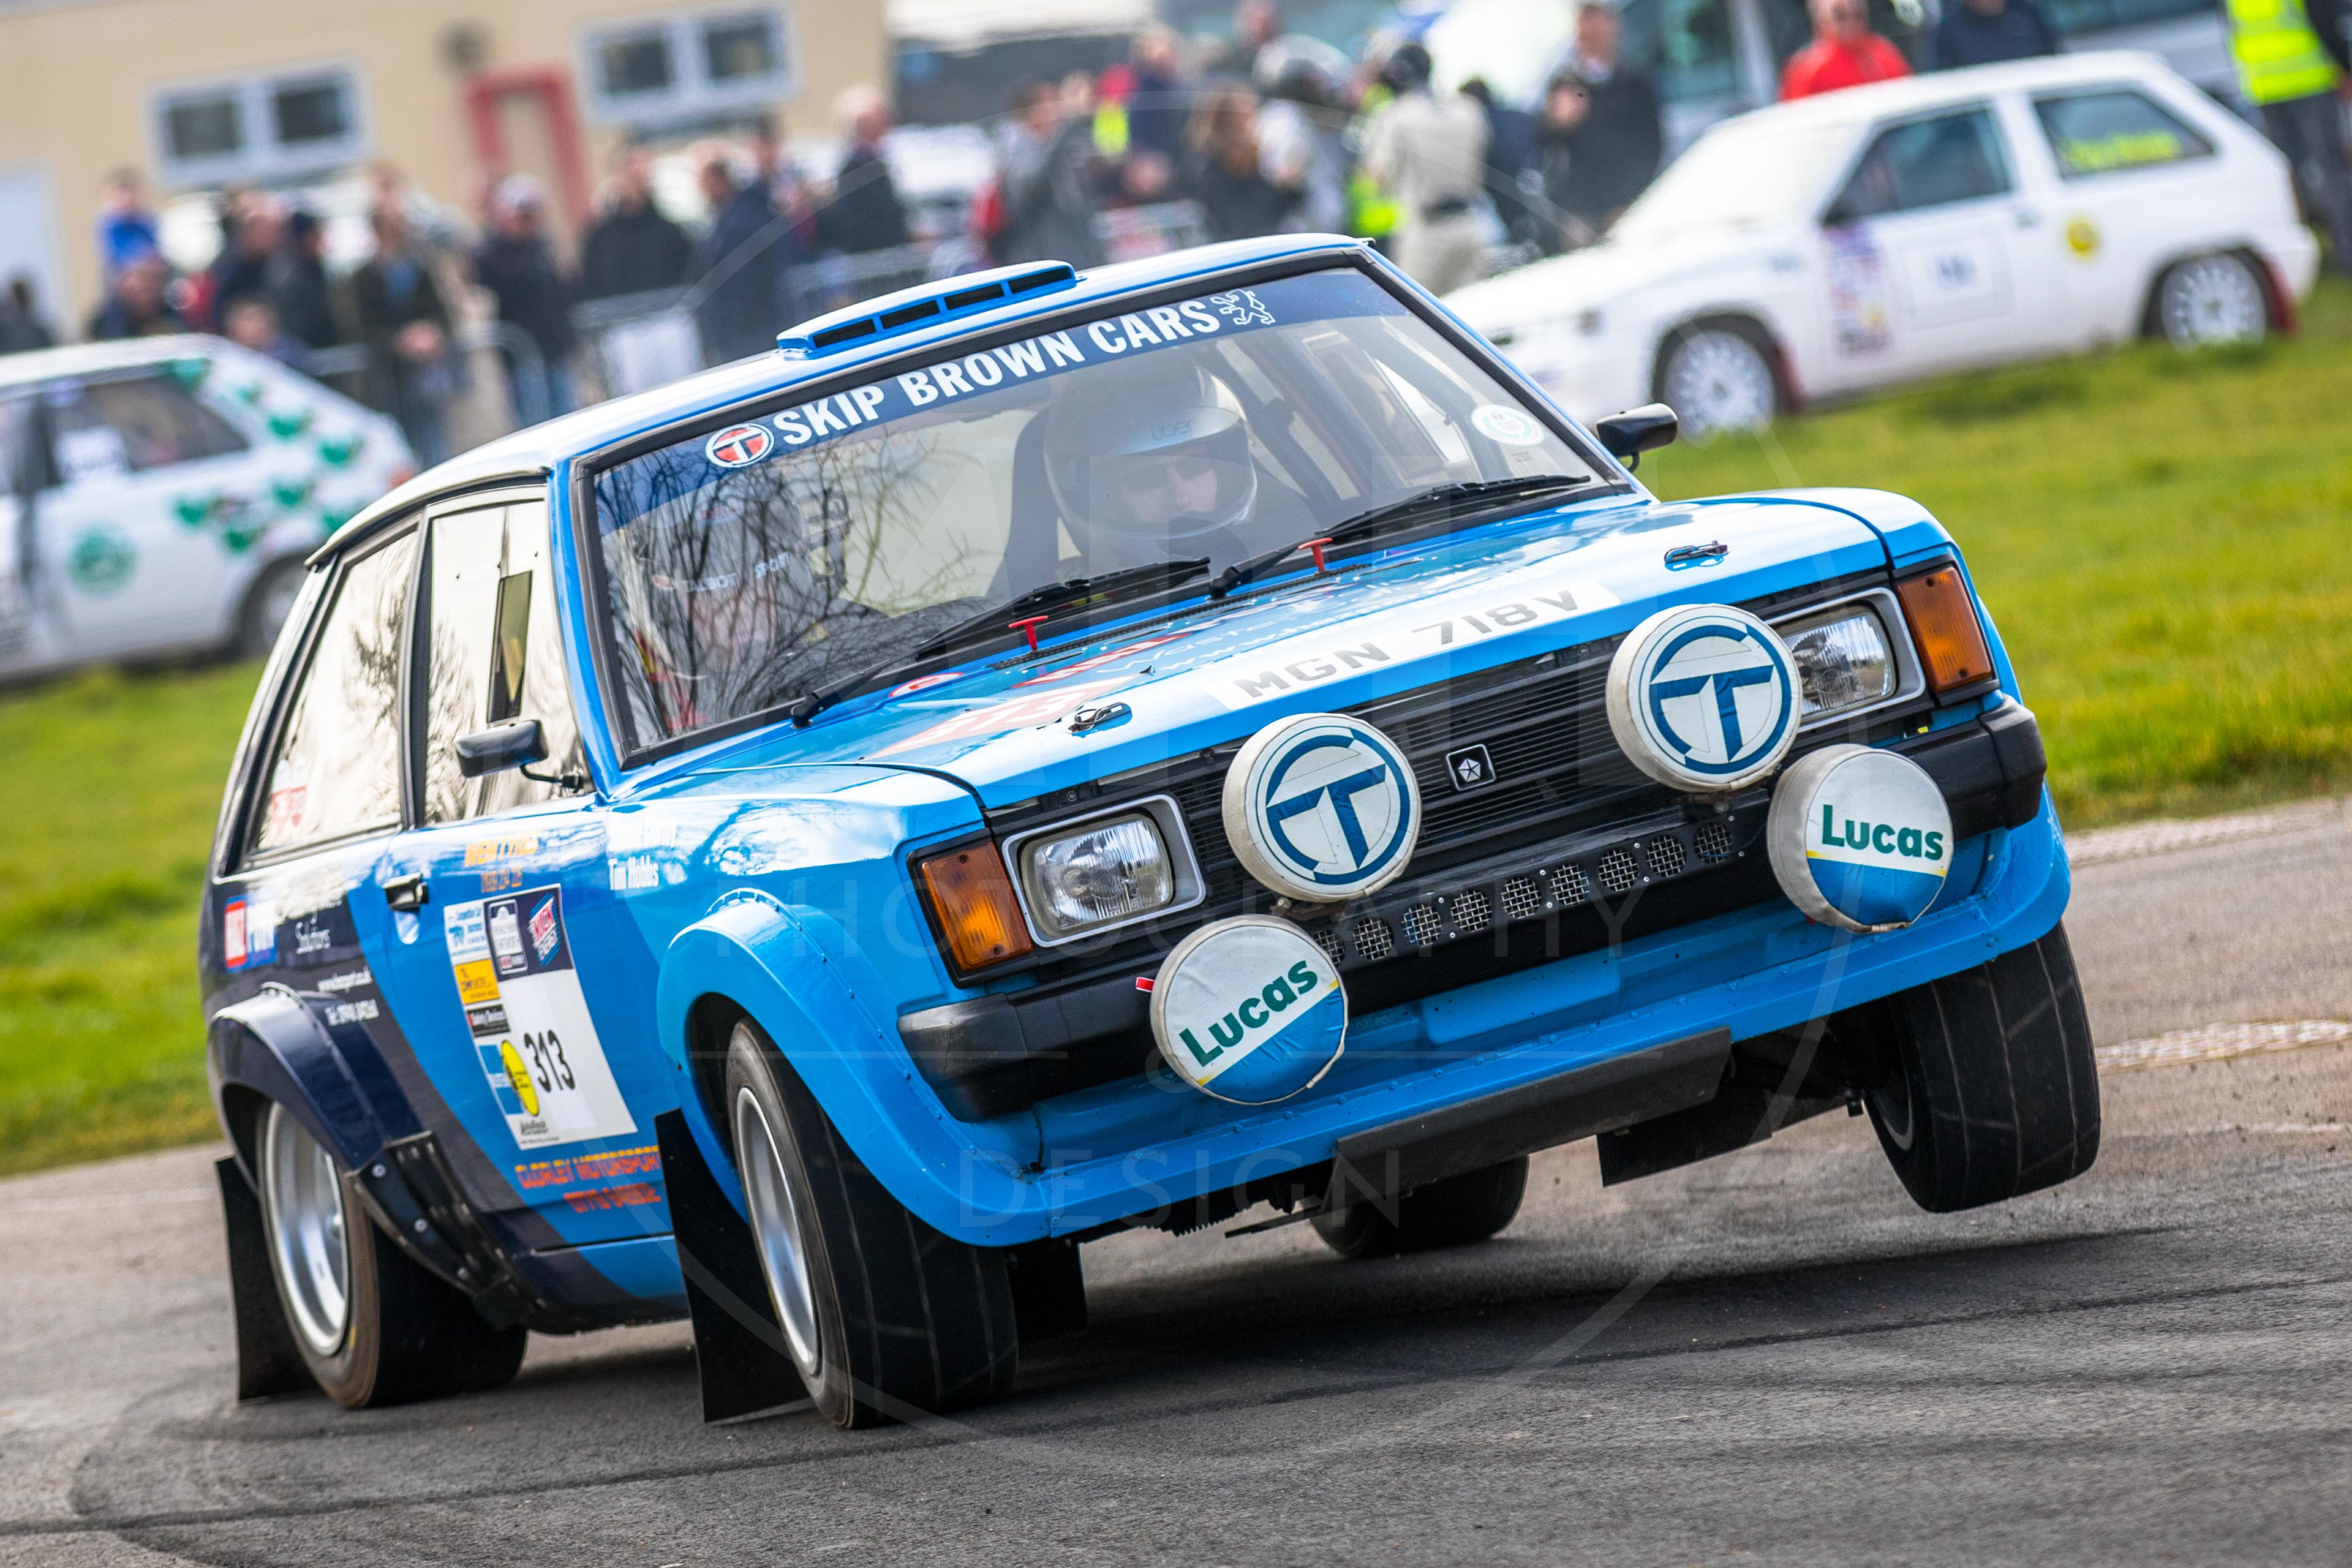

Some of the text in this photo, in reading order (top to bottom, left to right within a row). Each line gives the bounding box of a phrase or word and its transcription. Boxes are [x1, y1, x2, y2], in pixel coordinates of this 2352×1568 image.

[772, 298, 1221, 445] SKIP BROWN CARS
[1234, 589, 1580, 698] MGN 718V
[1821, 804, 1946, 861] Lucas
[524, 1030, 575, 1093] 313
[1178, 959, 1319, 1067] Lucas
